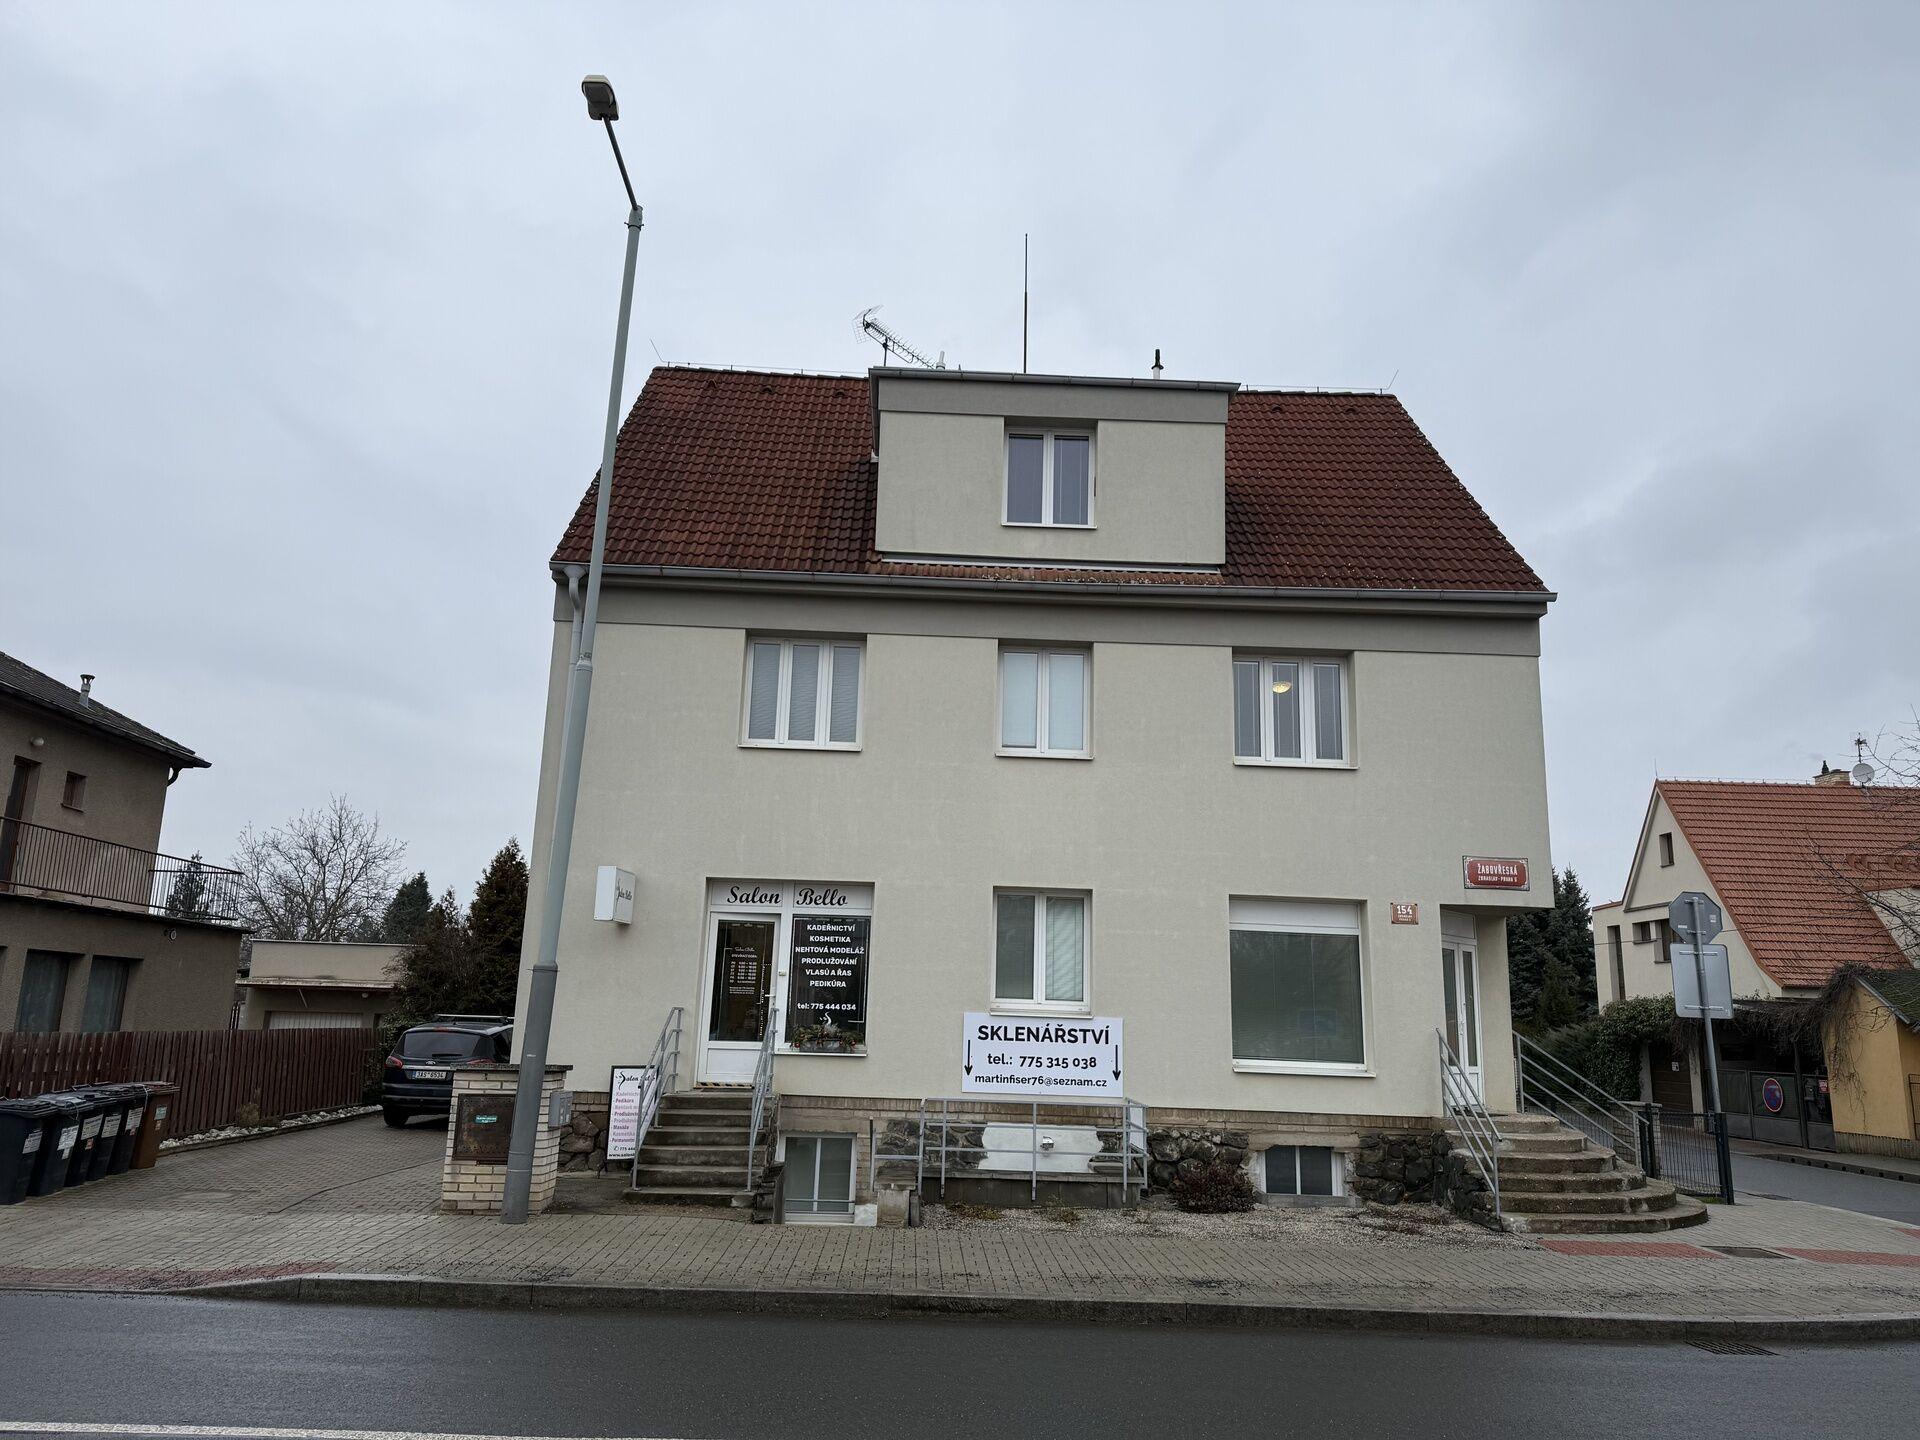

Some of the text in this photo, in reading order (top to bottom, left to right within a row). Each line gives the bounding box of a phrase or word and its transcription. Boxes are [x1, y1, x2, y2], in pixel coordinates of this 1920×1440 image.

[1477, 863, 1518, 875] ŽABOVŘESKÁ
[727, 886, 848, 906] Salon Bello
[1396, 906, 1412, 914] 154
[806, 924, 856, 932] KADEŘNICTVÍ
[802, 957, 858, 965] PRODLUŽOVÁNÍ
[837, 968, 852, 976] ŘAS
[978, 1023, 1110, 1044] SKLENÁŘSTVÍ
[987, 1053, 1097, 1070] tel.: 775 315 038
[975, 1074, 1107, 1087] martinfiser76@seznam.cz
